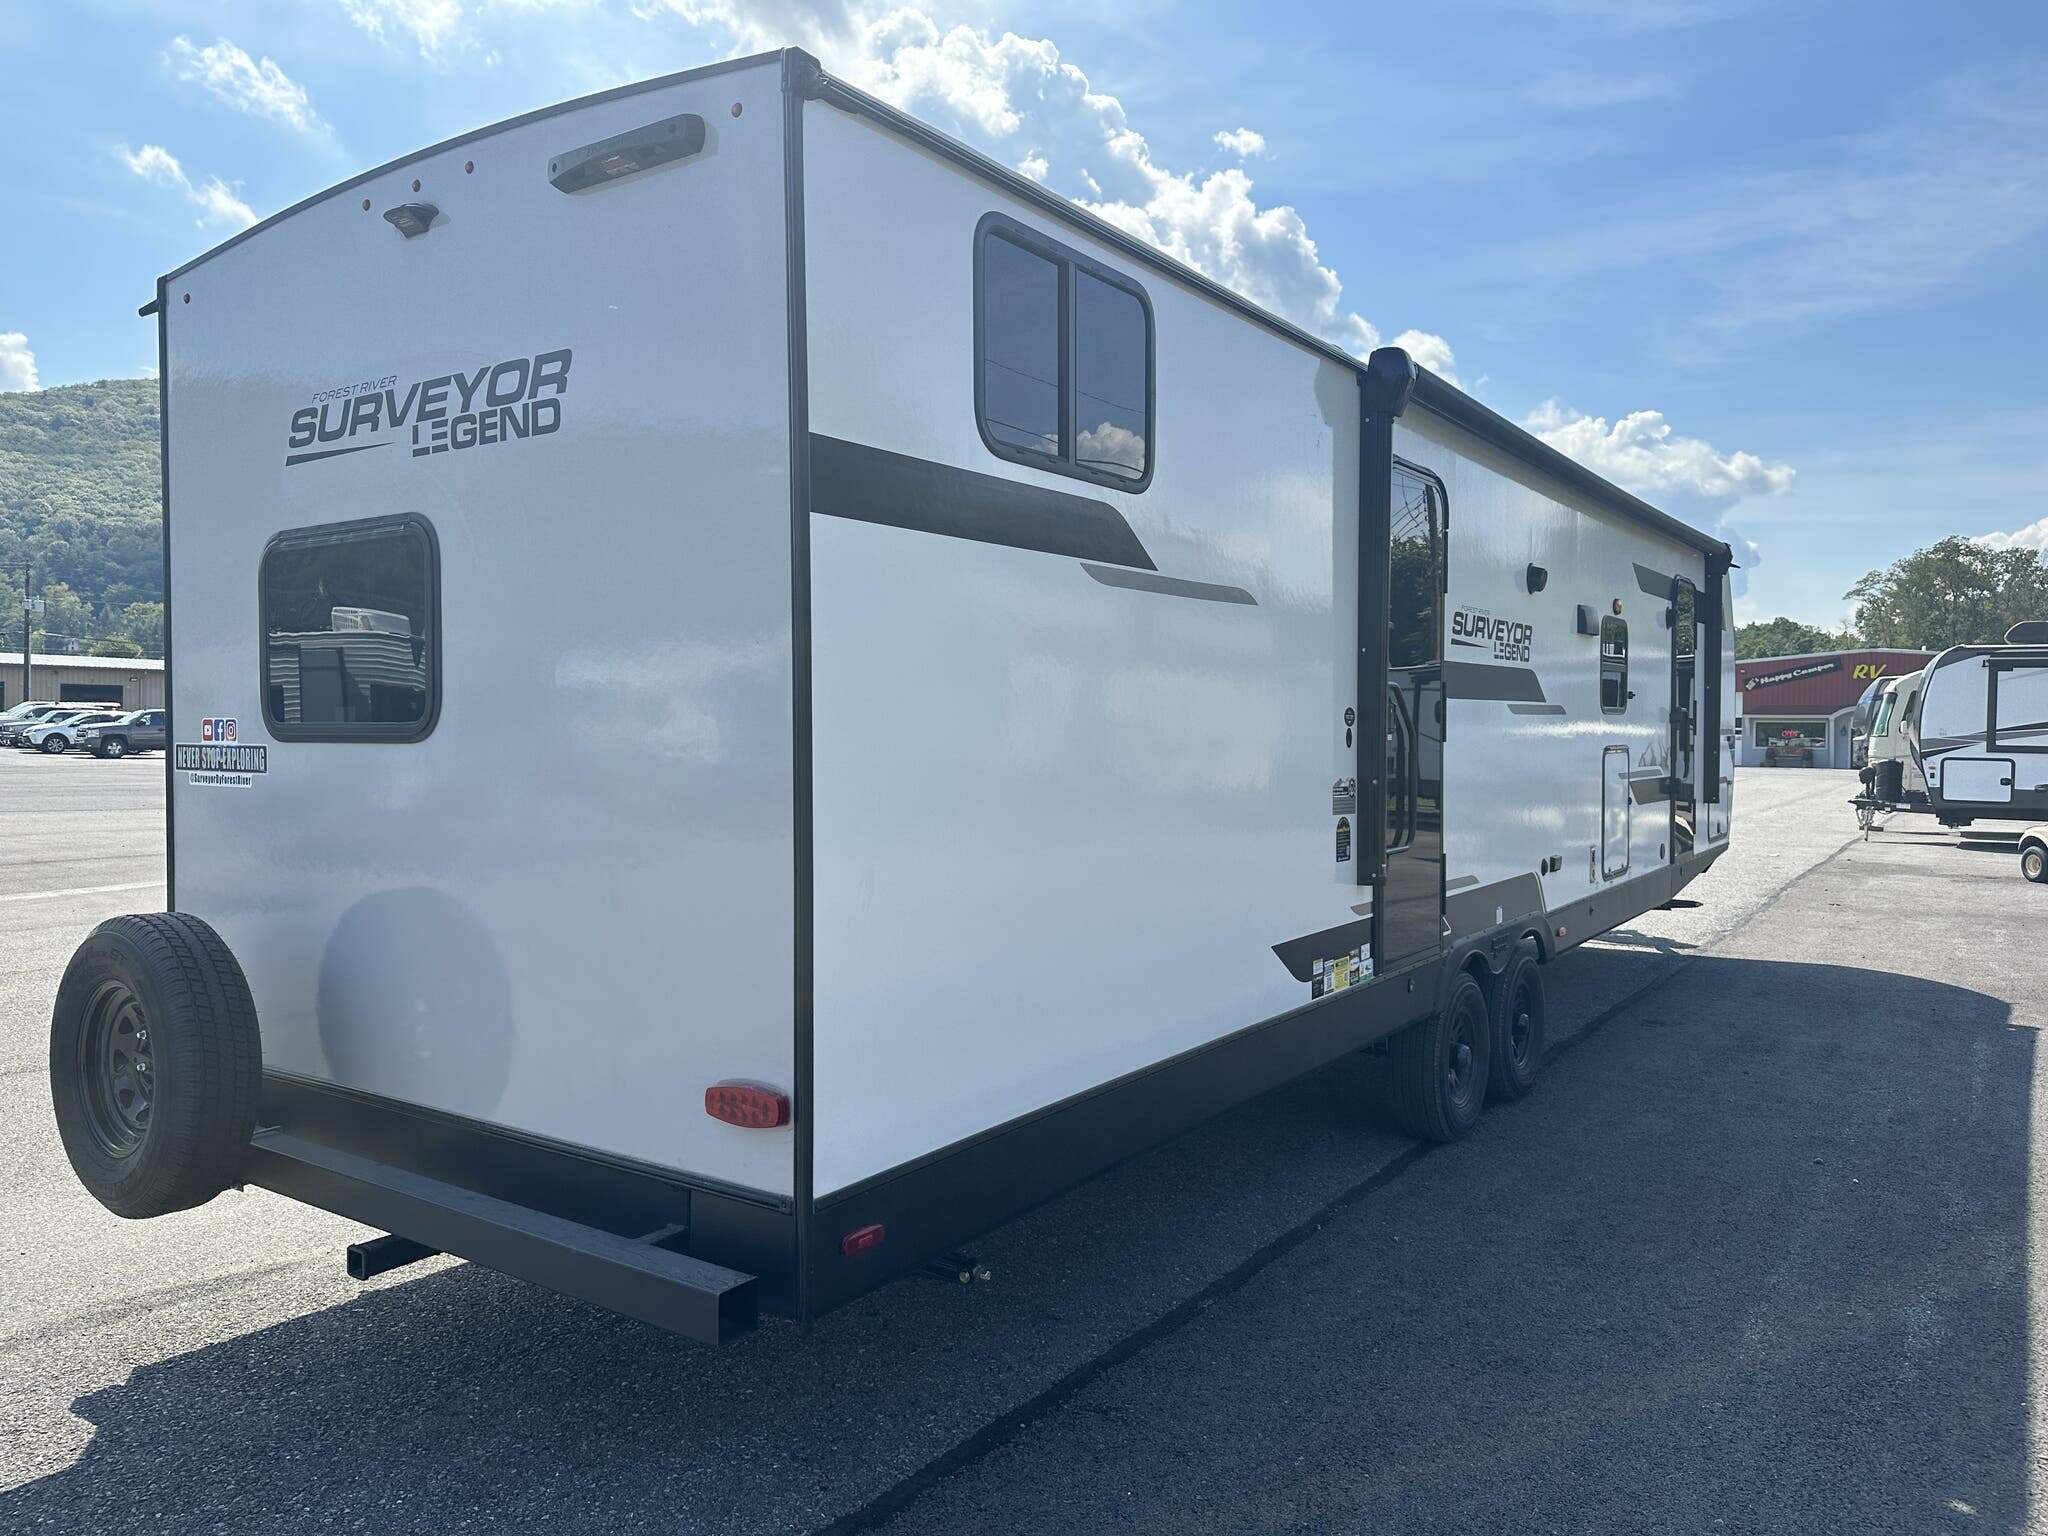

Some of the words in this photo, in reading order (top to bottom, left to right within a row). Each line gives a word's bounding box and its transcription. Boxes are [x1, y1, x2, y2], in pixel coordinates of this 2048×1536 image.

[288, 348, 573, 448] SURVEYOR
[311, 384, 357, 404] FOREST
[359, 375, 398, 393] RIVER
[412, 397, 562, 458] LEGEND
[1452, 611, 1533, 646] SURVEYOR
[1494, 641, 1530, 663] LEGEND
[1760, 673, 1792, 684] Happy
[1852, 663, 1887, 680] RV
[177, 746, 200, 769] NEVER
[222, 748, 265, 771] EXPLORING
